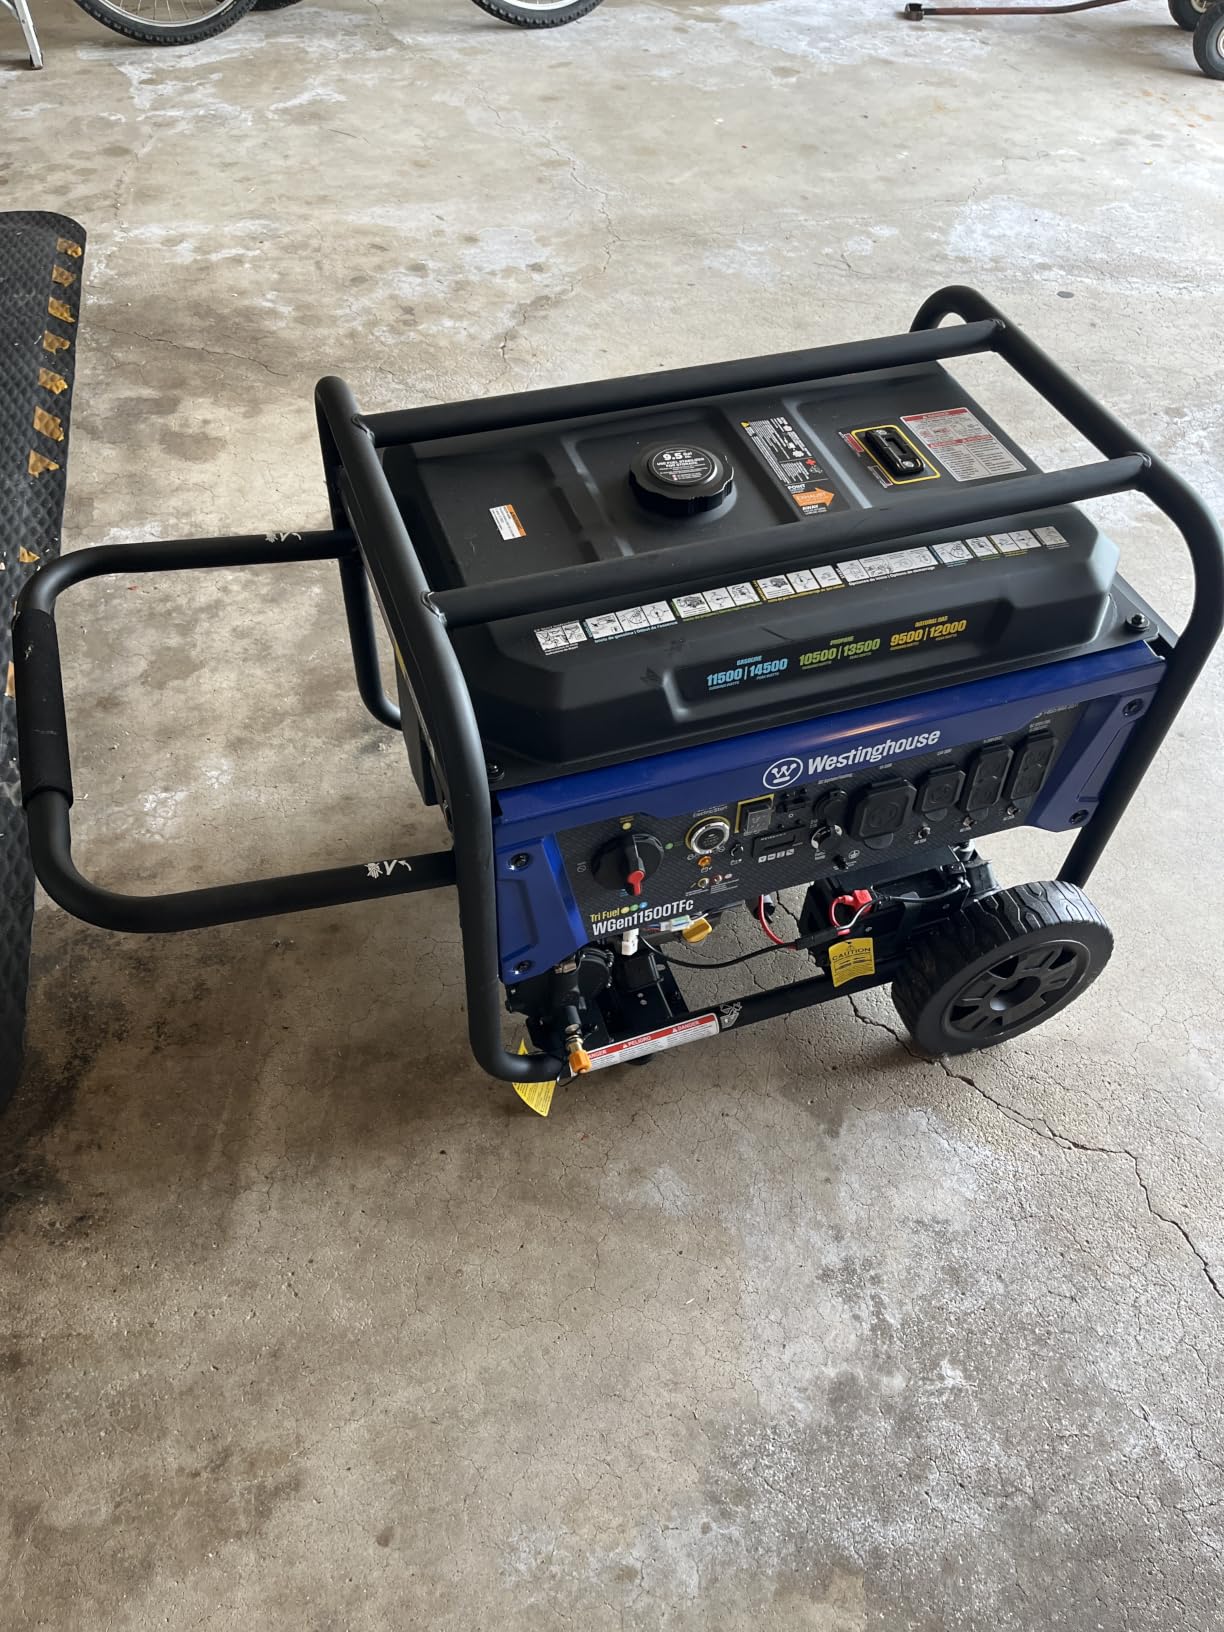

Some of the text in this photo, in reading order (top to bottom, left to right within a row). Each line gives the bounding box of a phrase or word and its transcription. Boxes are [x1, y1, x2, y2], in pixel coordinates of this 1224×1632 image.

[890, 629, 924, 646] 9500
[929, 620, 967, 638] 12000
[799, 647, 837, 666] 10500
[843, 638, 881, 657] 13500
[706, 668, 743, 687] 11500
[749, 658, 788, 677] 14500
[808, 730, 941, 775] Westinghouse
[590, 908, 620, 922] Tri Fuel
[832, 947, 871, 961] CAUTION
